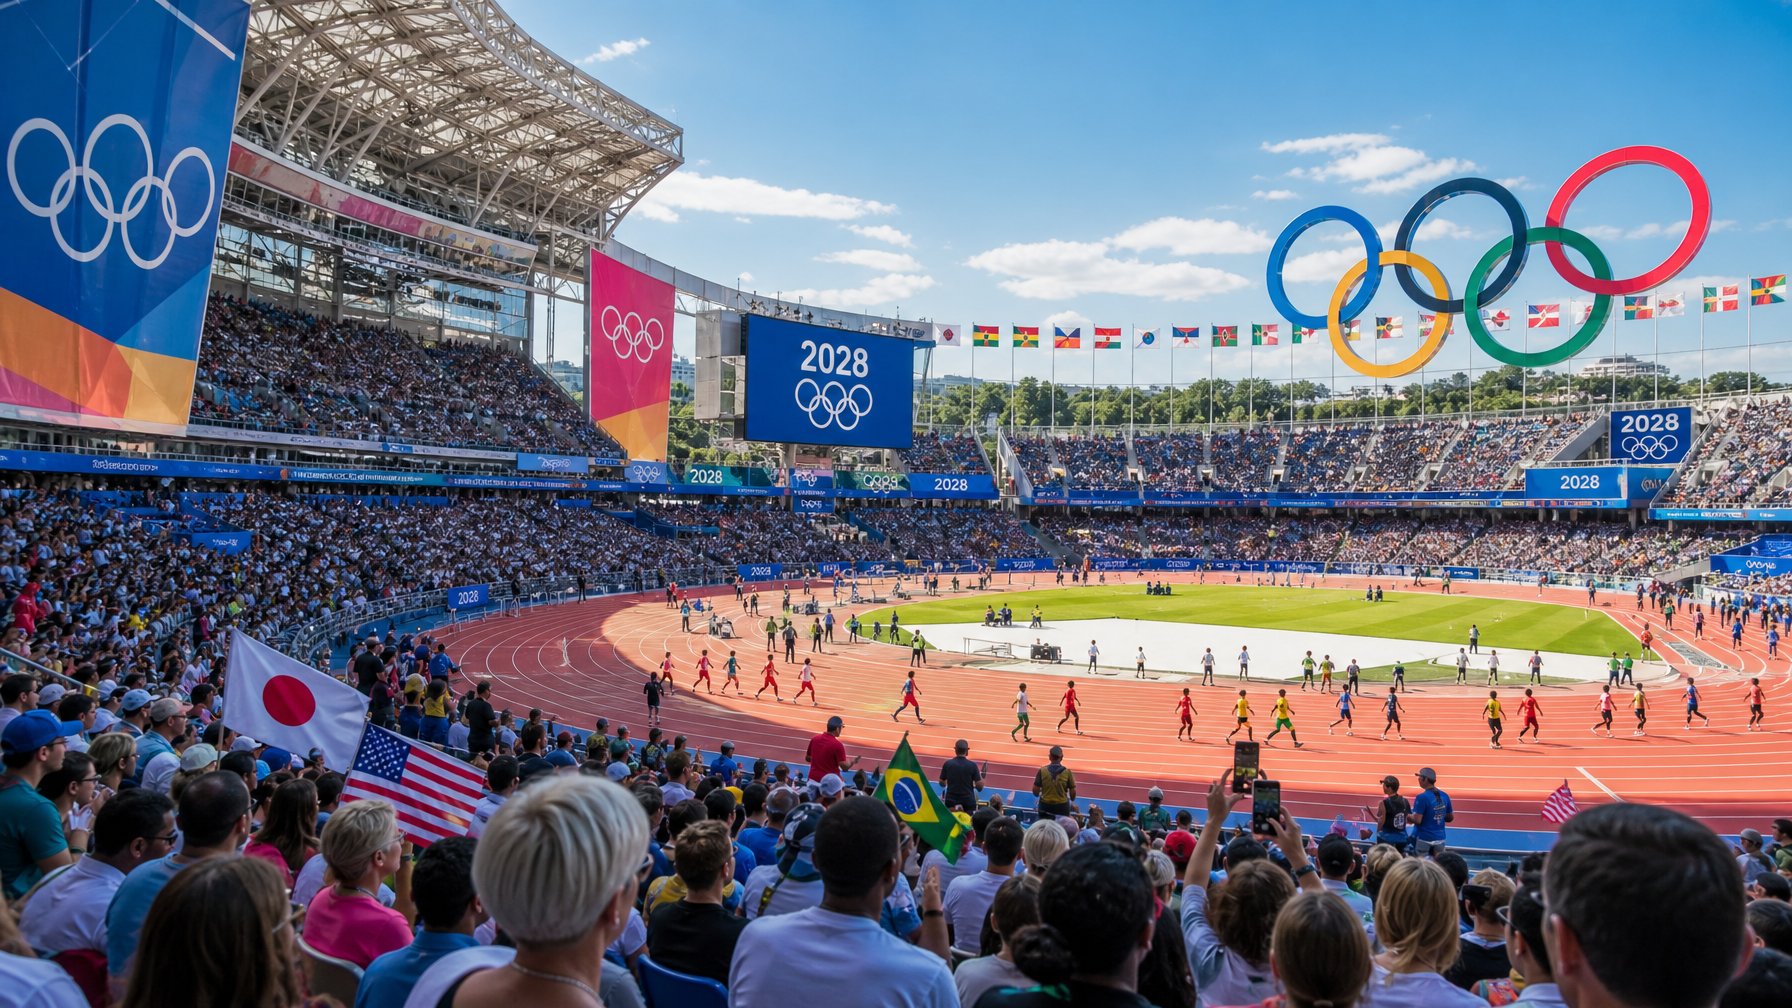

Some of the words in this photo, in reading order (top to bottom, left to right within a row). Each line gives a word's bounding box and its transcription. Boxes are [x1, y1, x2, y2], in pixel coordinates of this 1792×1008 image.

[800, 339, 869, 378] 2028
[1621, 412, 1679, 433] 2028
[690, 468, 723, 484] 2028
[1560, 475, 1600, 490] 2028
[934, 478, 968, 491] 2028
[458, 590, 479, 605] 2028
